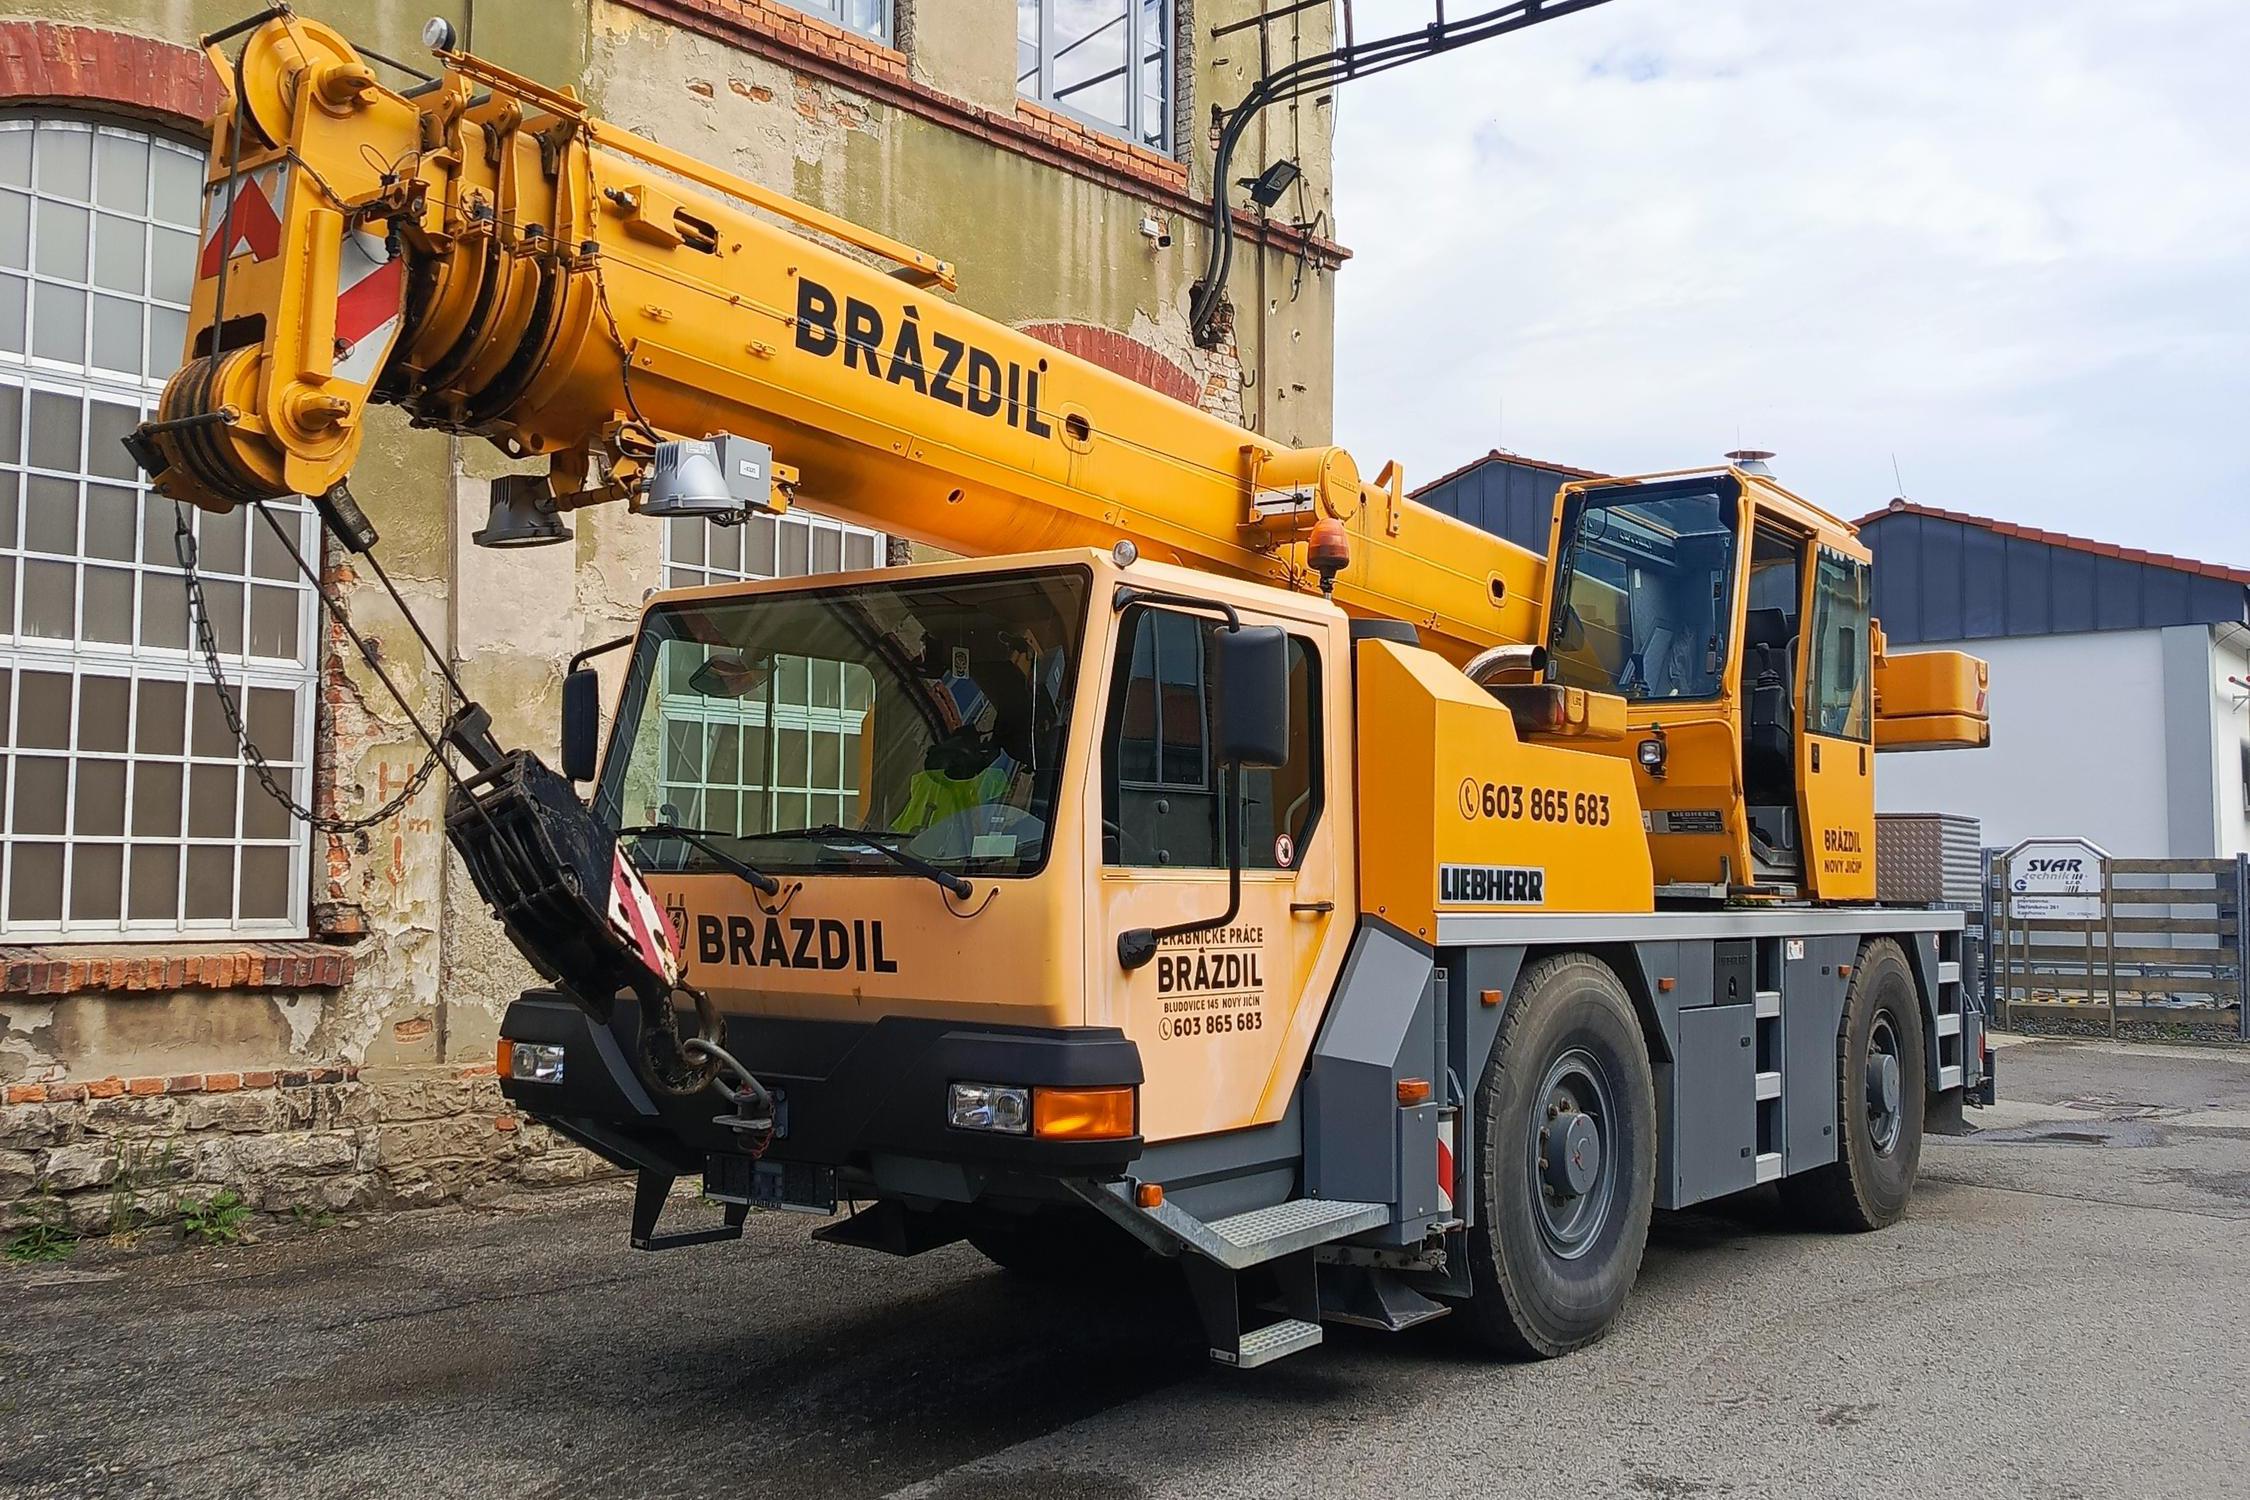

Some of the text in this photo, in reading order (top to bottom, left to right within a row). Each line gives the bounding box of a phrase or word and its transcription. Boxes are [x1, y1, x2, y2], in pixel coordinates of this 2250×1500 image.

[1482, 783, 1523, 819] 603
[1530, 788, 1569, 823] 865
[1574, 793, 1610, 827] 683
[1824, 825, 1861, 853] BRÁZDIL
[1824, 857, 1843, 873] NOVÝ
[2022, 872, 2070, 880] technik
[2027, 859, 2083, 872] SVAR
[1441, 868, 1543, 902] LIEBHERR
[697, 905, 898, 974] BRÁZDIL
[1230, 923, 1263, 943] PRÁCE
[1158, 946, 1263, 993] BRÁZDIL
[1164, 994, 1260, 1013] BLUDOVICE 145 NOVÝ JIČÍN
[1174, 1012, 1262, 1037] 603 865 683
